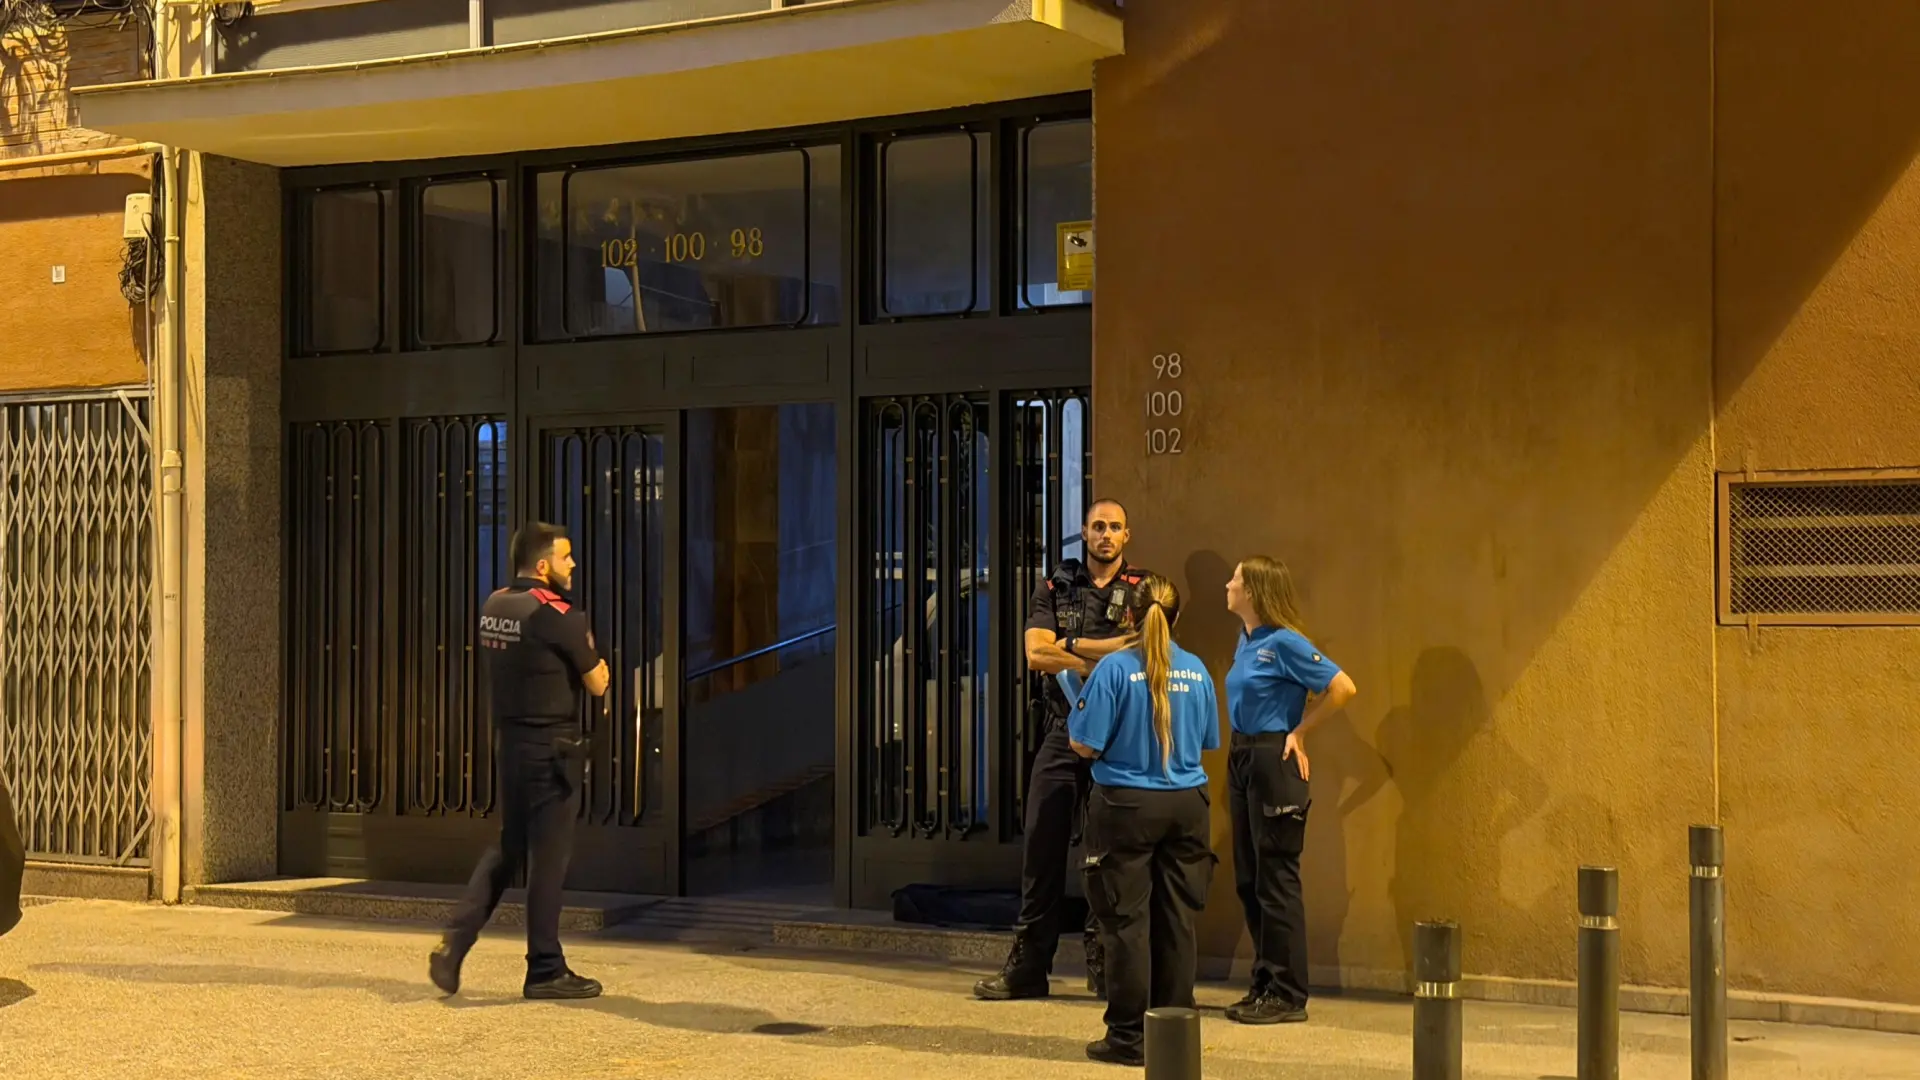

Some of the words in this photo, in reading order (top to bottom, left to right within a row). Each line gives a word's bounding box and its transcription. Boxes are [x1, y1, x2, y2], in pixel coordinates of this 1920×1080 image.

[601, 239, 637, 267] 102
[664, 232, 705, 262] 100
[730, 228, 763, 257] 98
[1152, 352, 1182, 380] 98
[1145, 390, 1182, 417] 100
[1144, 427, 1182, 455] 102
[480, 615, 521, 634] POLICIA
